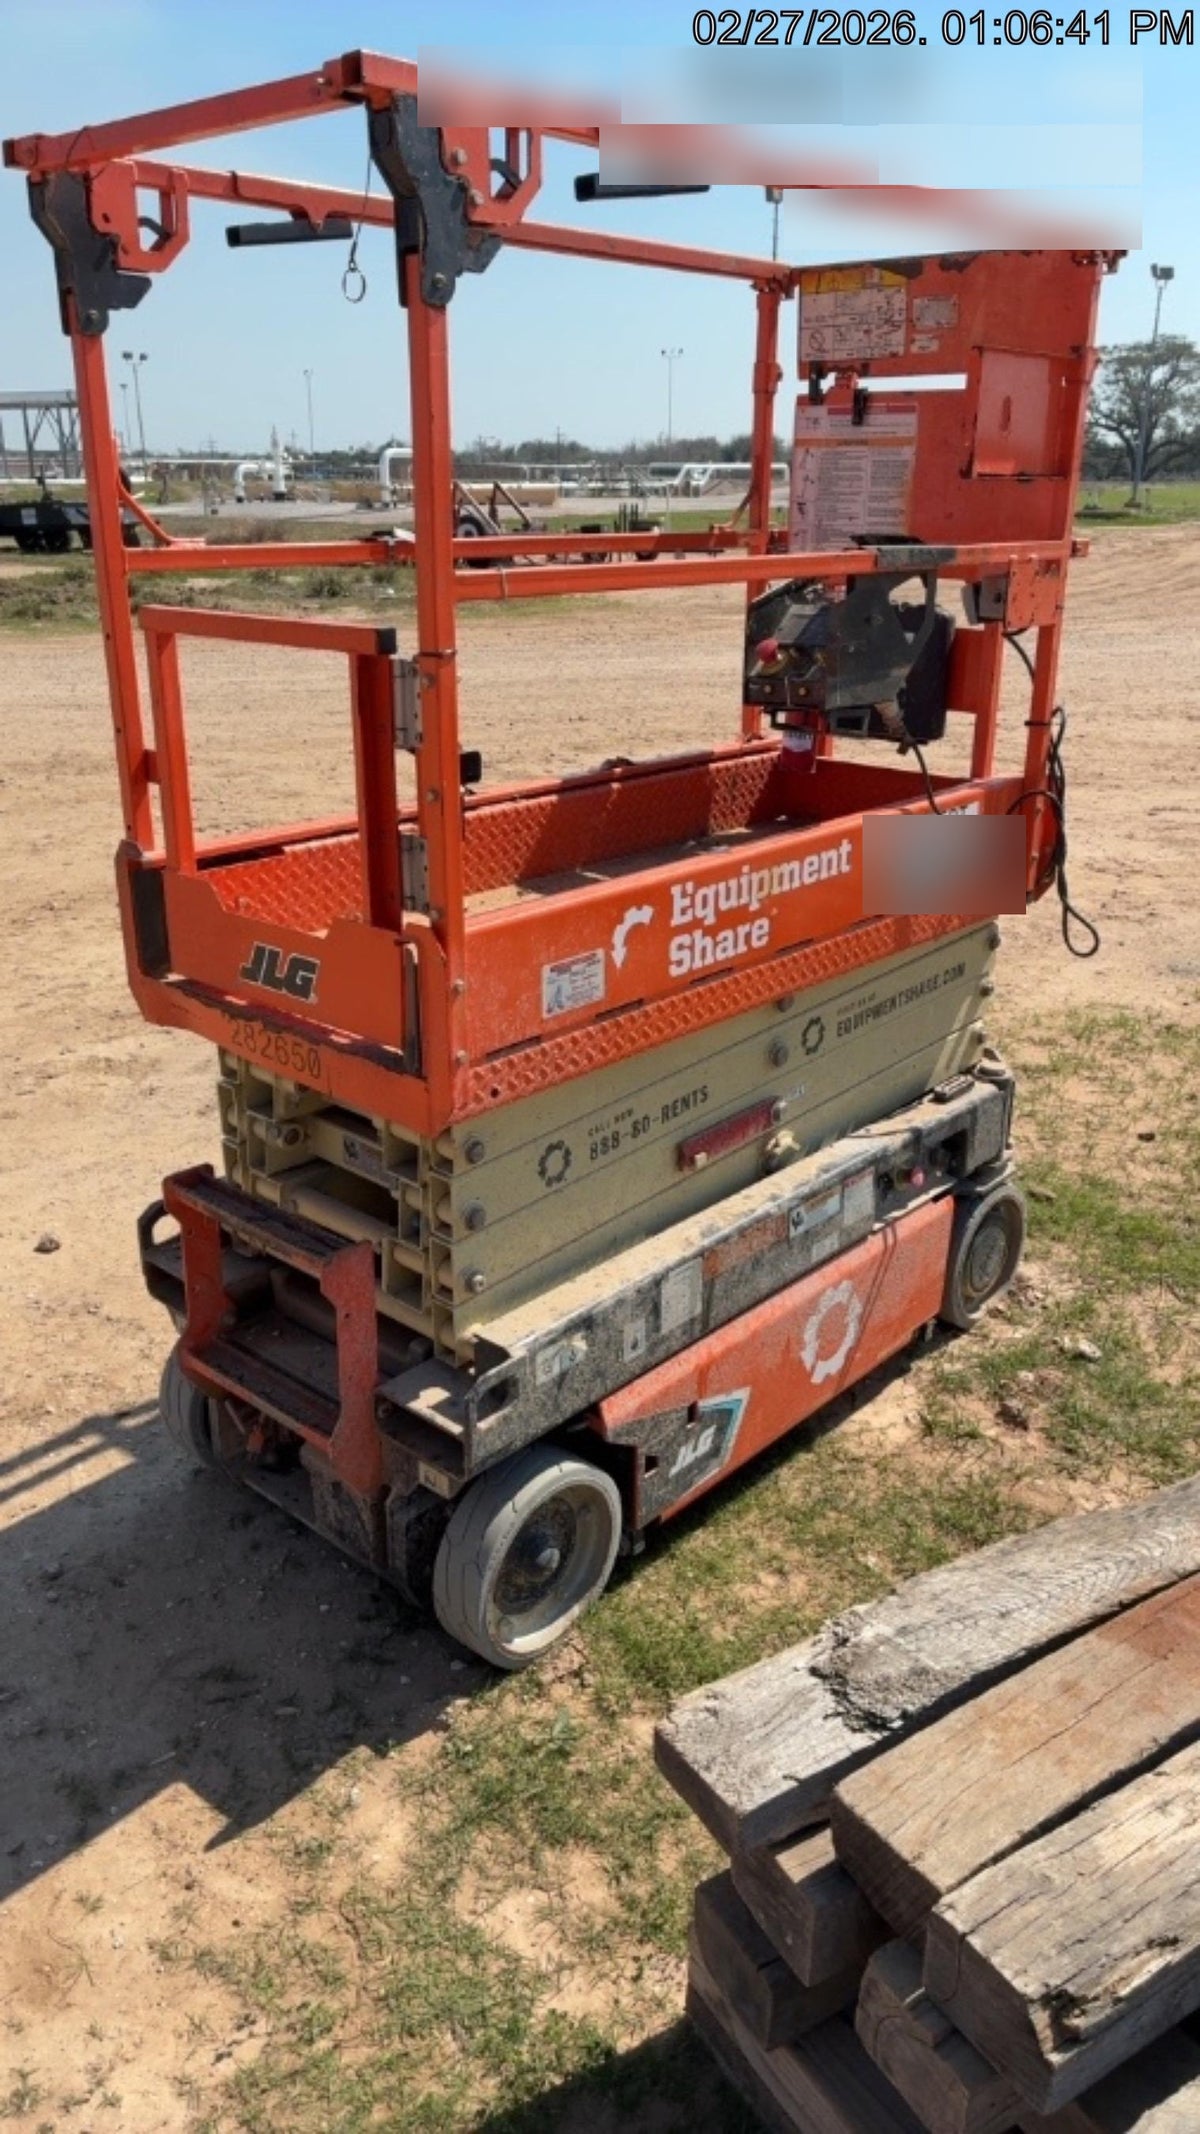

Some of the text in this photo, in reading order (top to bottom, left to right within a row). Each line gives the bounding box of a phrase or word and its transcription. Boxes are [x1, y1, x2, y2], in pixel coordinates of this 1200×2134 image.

[670, 838, 852, 928] Equipment
[240, 940, 321, 1004] JLG
[668, 916, 770, 978] Share
[230, 1019, 322, 1079] 282650
